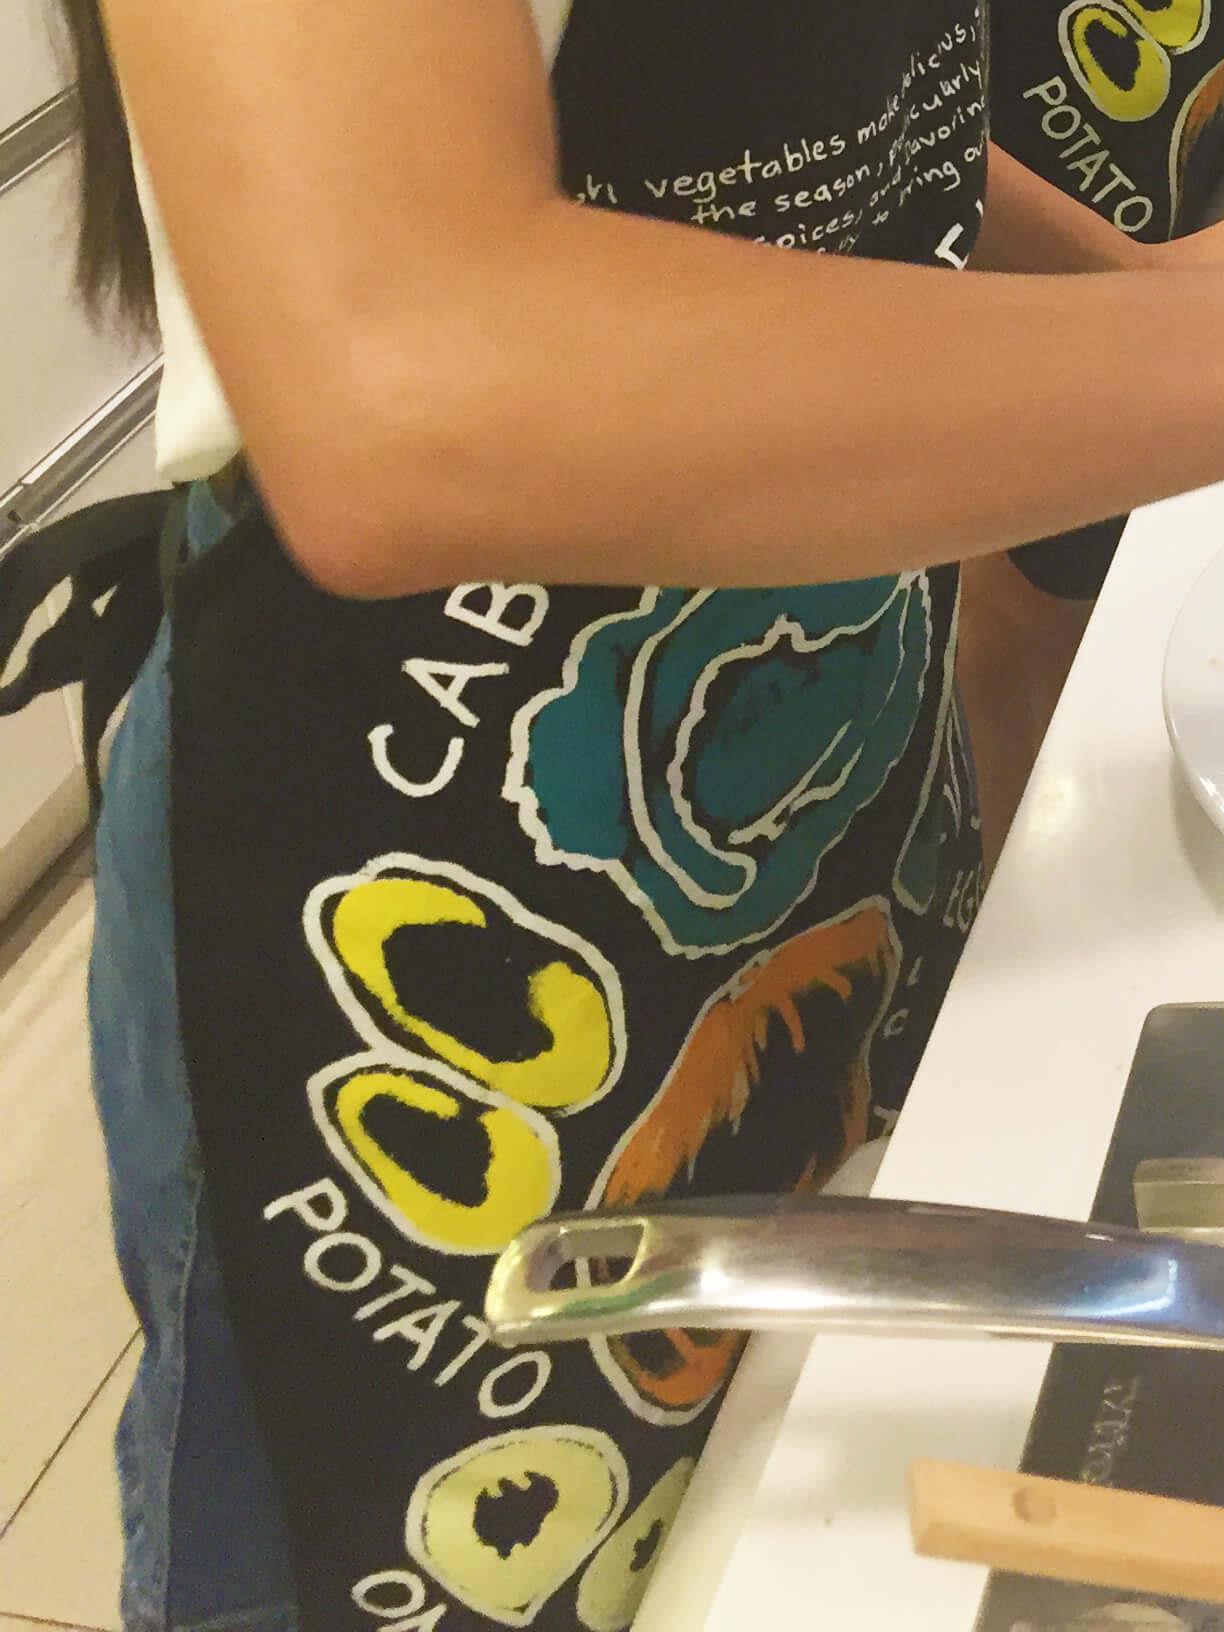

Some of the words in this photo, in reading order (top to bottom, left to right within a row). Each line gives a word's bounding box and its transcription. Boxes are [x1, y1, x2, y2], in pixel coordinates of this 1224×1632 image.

[644, 133, 846, 204] vegetables
[690, 200, 756, 224] the
[774, 162, 884, 213] season,
[1022, 75, 1154, 233] POTATO
[262, 1176, 552, 1419] POTATO
